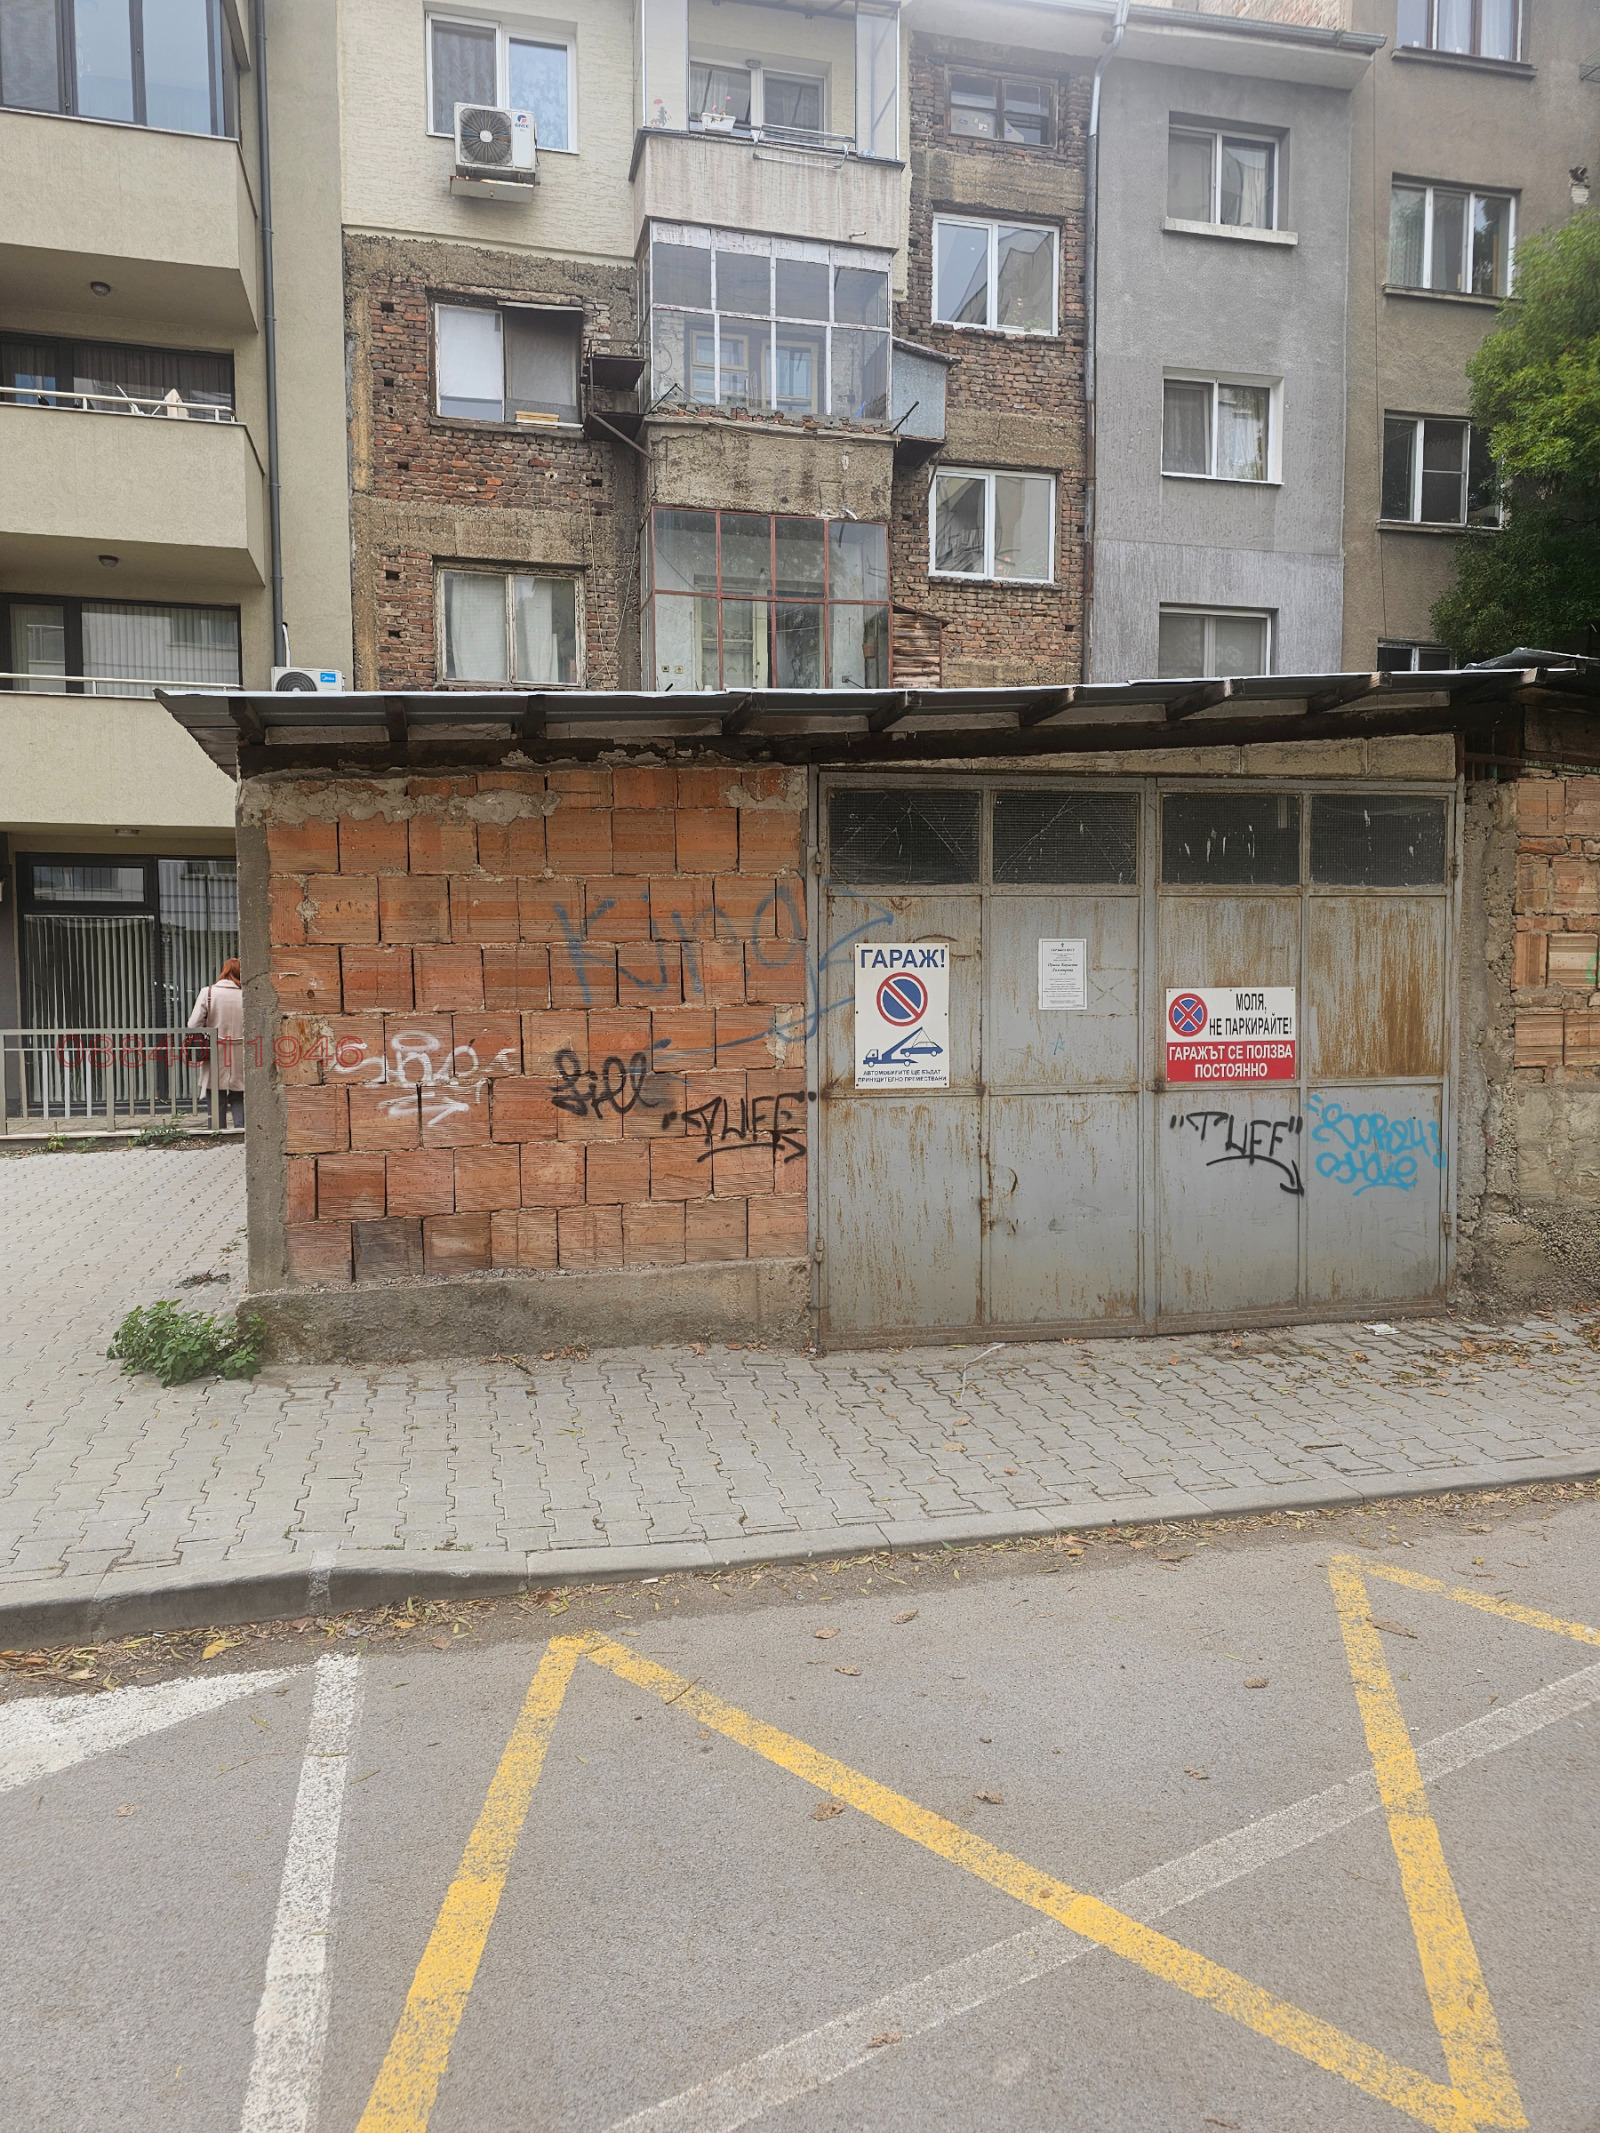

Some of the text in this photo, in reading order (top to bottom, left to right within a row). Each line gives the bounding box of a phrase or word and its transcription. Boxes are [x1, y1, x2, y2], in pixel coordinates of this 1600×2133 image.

[860, 949, 945, 969] ГАРАЖ!
[1235, 993, 1267, 1014] МОЛЯ,
[1209, 1012, 1292, 1036] НЕ ПАРКИРАЙТЕ!
[1169, 1044, 1293, 1061] ГАРАЖЪТ СЕ ПОЛЗВА
[1195, 1063, 1268, 1078] ПОСТОЯННО
